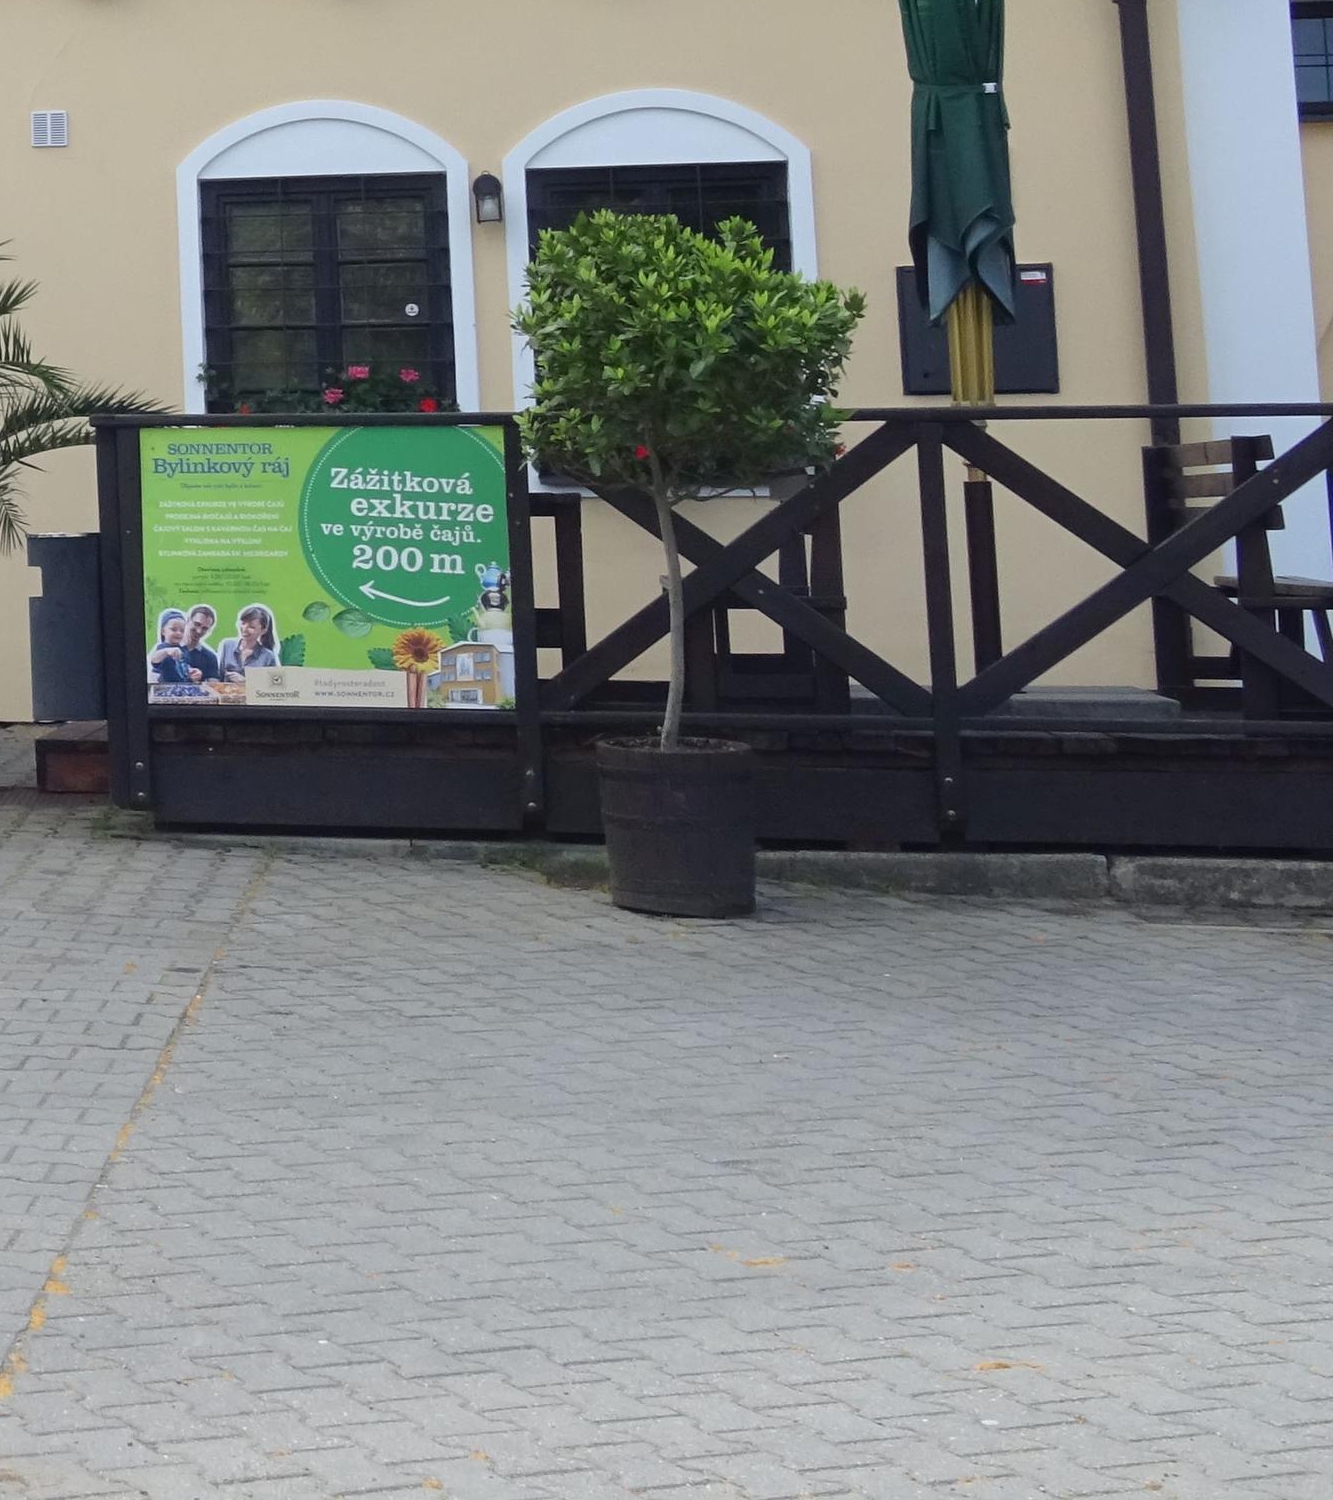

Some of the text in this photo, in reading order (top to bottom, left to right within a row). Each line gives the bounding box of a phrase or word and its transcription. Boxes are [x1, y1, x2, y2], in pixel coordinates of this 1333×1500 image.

[167, 443, 273, 456] SONNENTOR
[152, 457, 290, 478] Bylinkový ráj
[330, 467, 473, 495] Zážitková
[350, 494, 495, 523] exkurze
[320, 521, 482, 546] ve výrobě čajů.
[352, 544, 465, 574] 200 m
